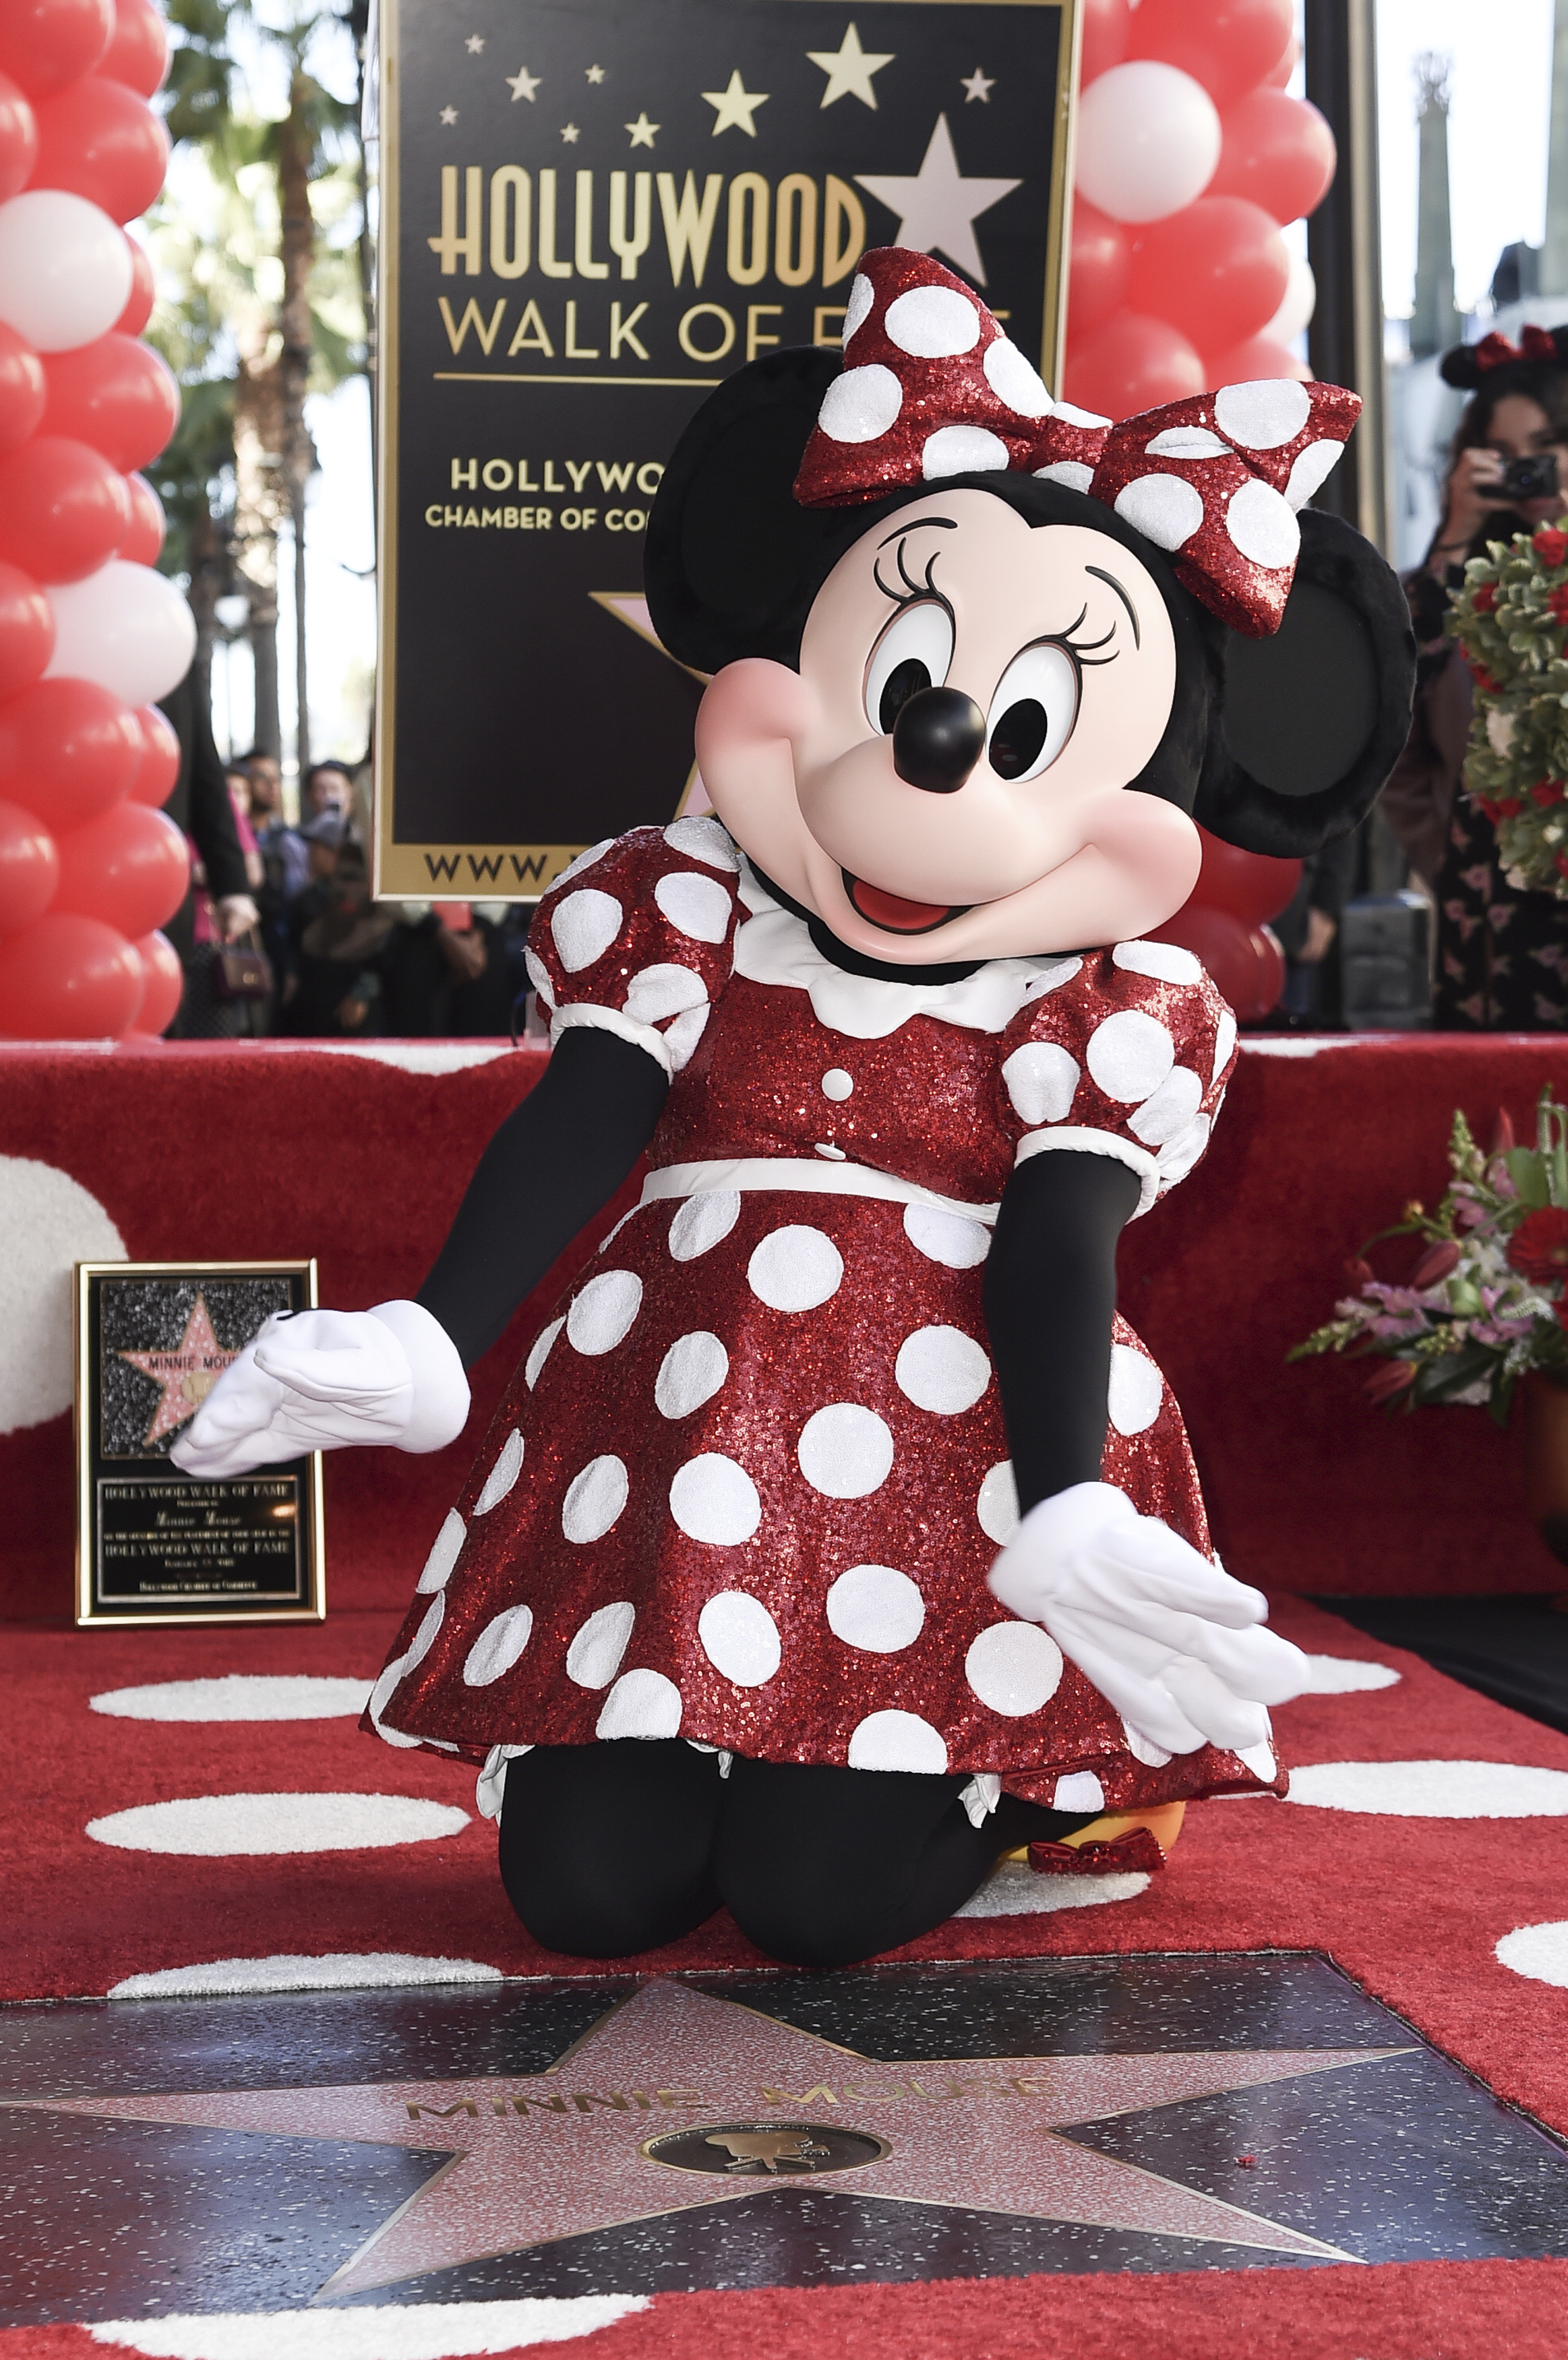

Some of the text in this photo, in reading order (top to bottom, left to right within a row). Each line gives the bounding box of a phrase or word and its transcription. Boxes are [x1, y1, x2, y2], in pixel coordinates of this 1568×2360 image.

[427, 164, 867, 289] HOLLYWOOD
[438, 296, 650, 360] WALK
[677, 303, 783, 362] OF
[450, 458, 665, 495] HOLLYWO
[425, 504, 650, 532] CHAMBER OF CO
[148, 1355, 237, 1370] MINNIE MOU
[104, 1482, 289, 1499] HOLLYWOOD WALK OF FAME
[105, 1540, 290, 1557] HOLLYWOOD WALK OF FAME
[405, 2077, 1064, 2120] MINNIE MOUSE
